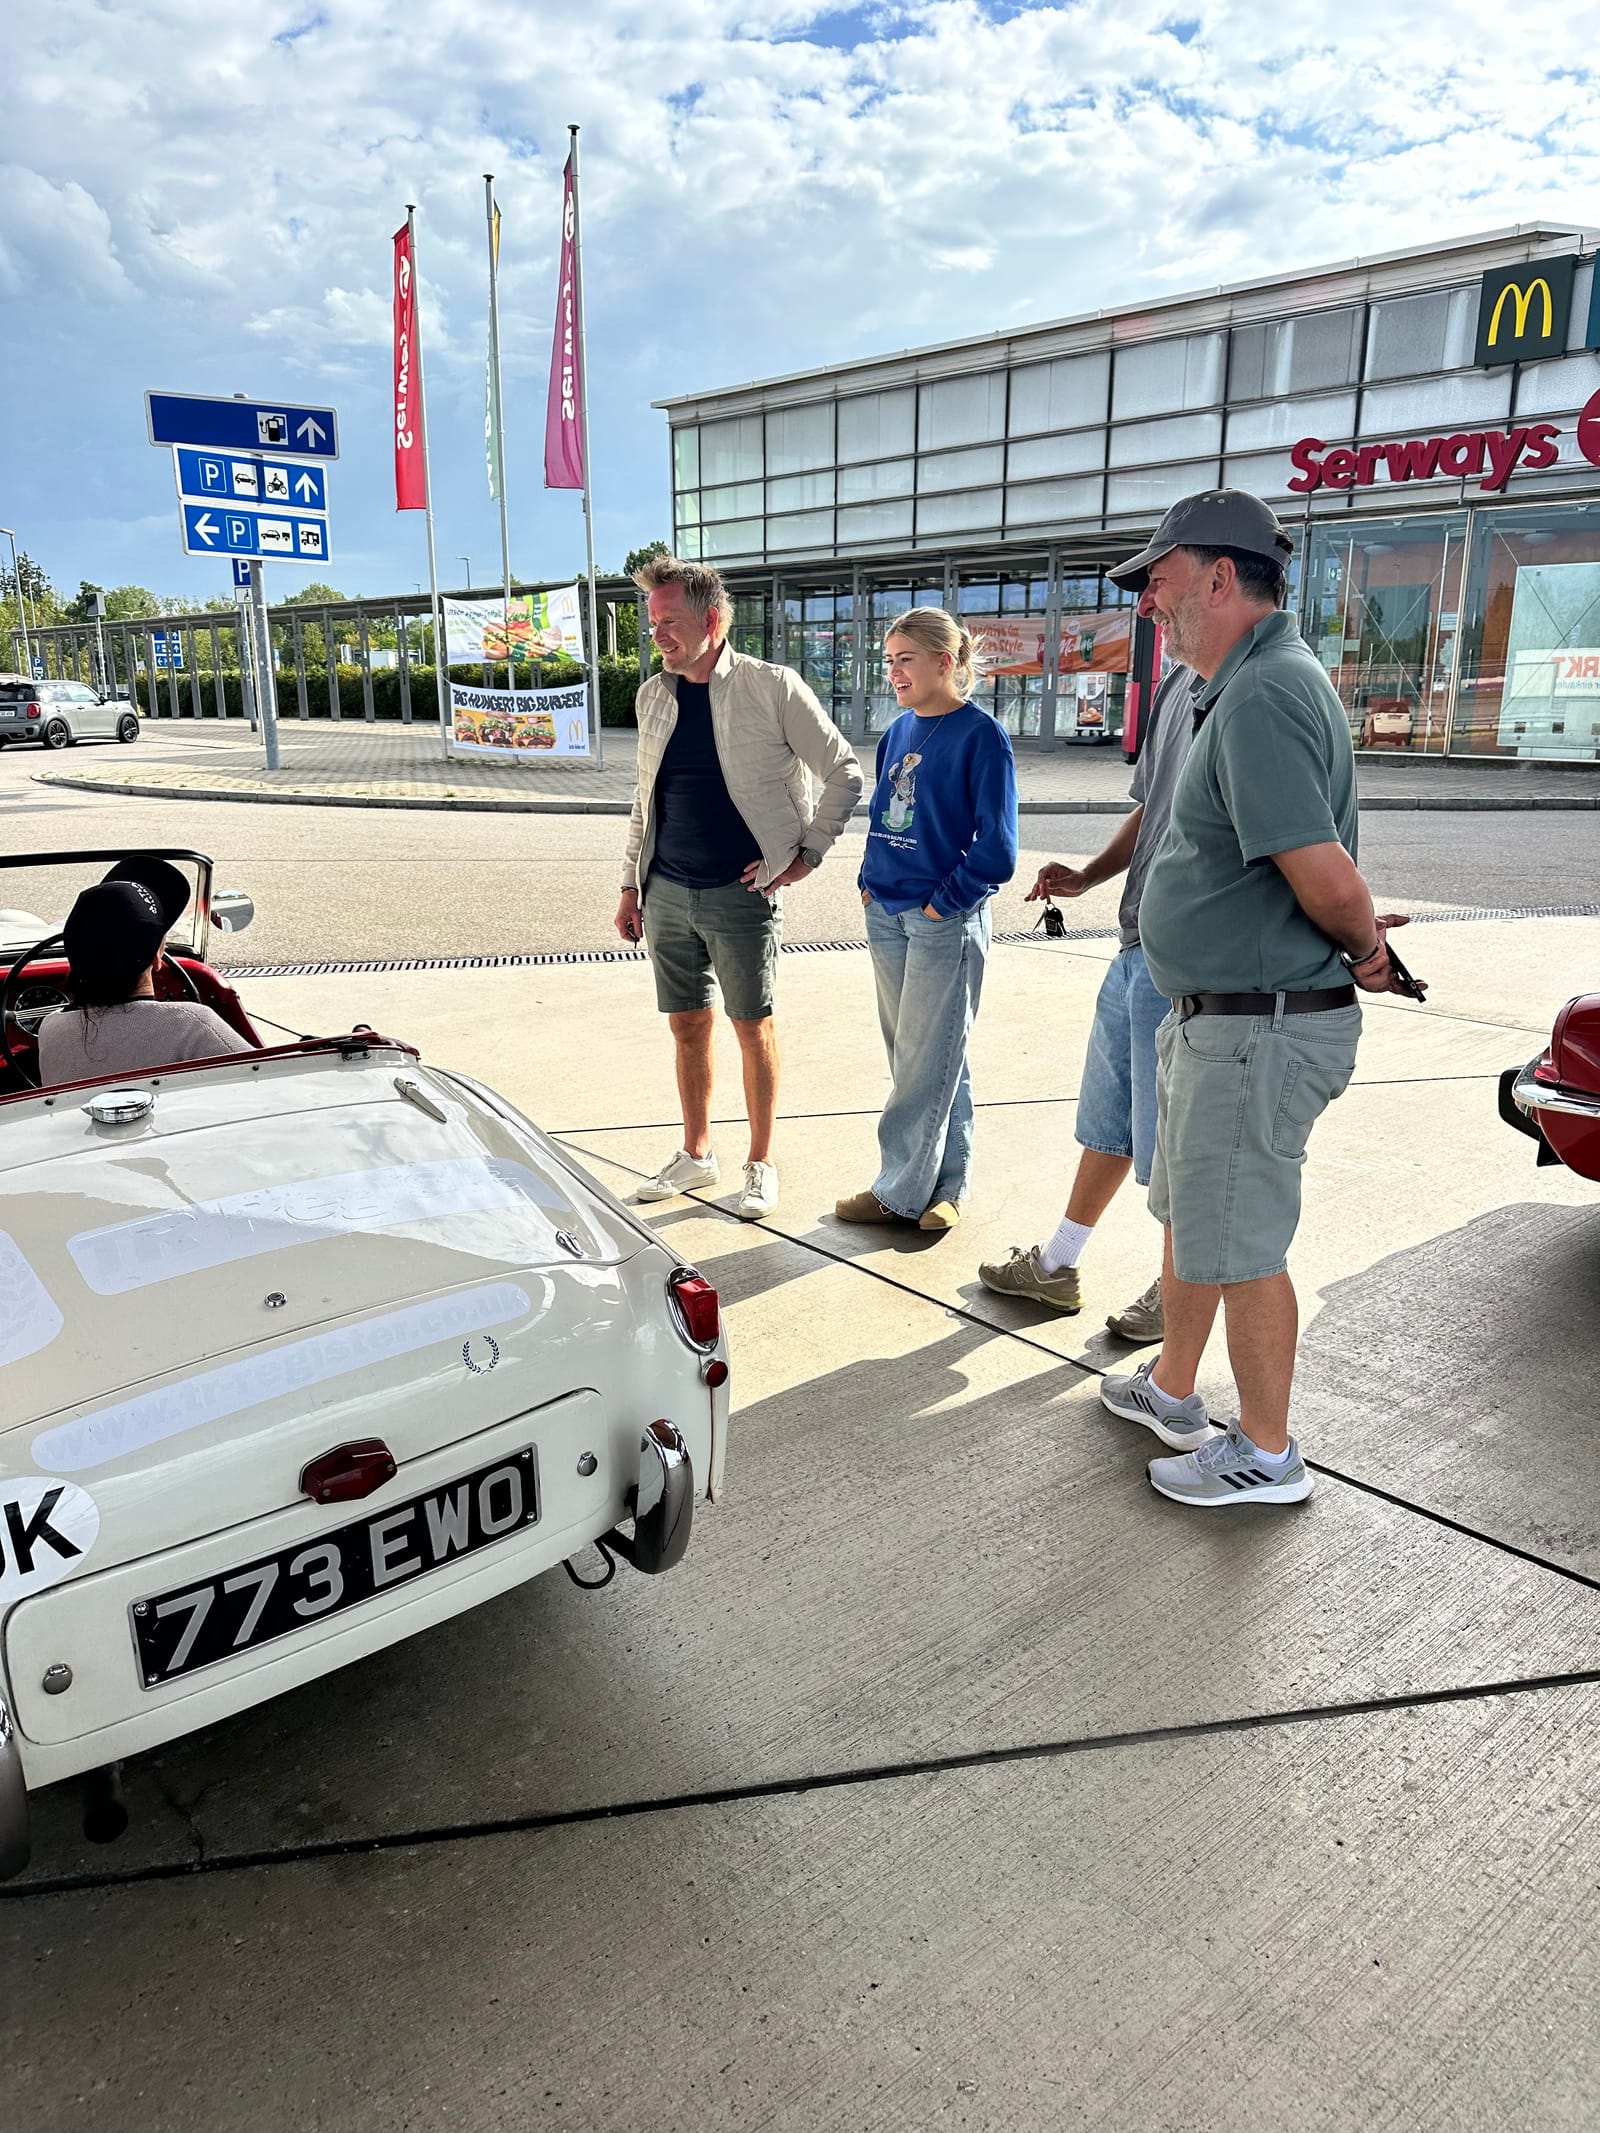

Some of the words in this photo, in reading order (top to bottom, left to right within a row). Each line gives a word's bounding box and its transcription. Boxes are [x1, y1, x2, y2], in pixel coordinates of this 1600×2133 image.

[1287, 423, 1561, 493] Serways
[205, 463, 219, 487] P
[232, 520, 245, 544] P
[238, 560, 250, 583] P
[35, 658, 41, 667] P
[516, 696, 536, 712] BIG
[0, 1486, 84, 1578] K
[155, 1541, 345, 1671] 773
[369, 1465, 523, 1587] EWO
